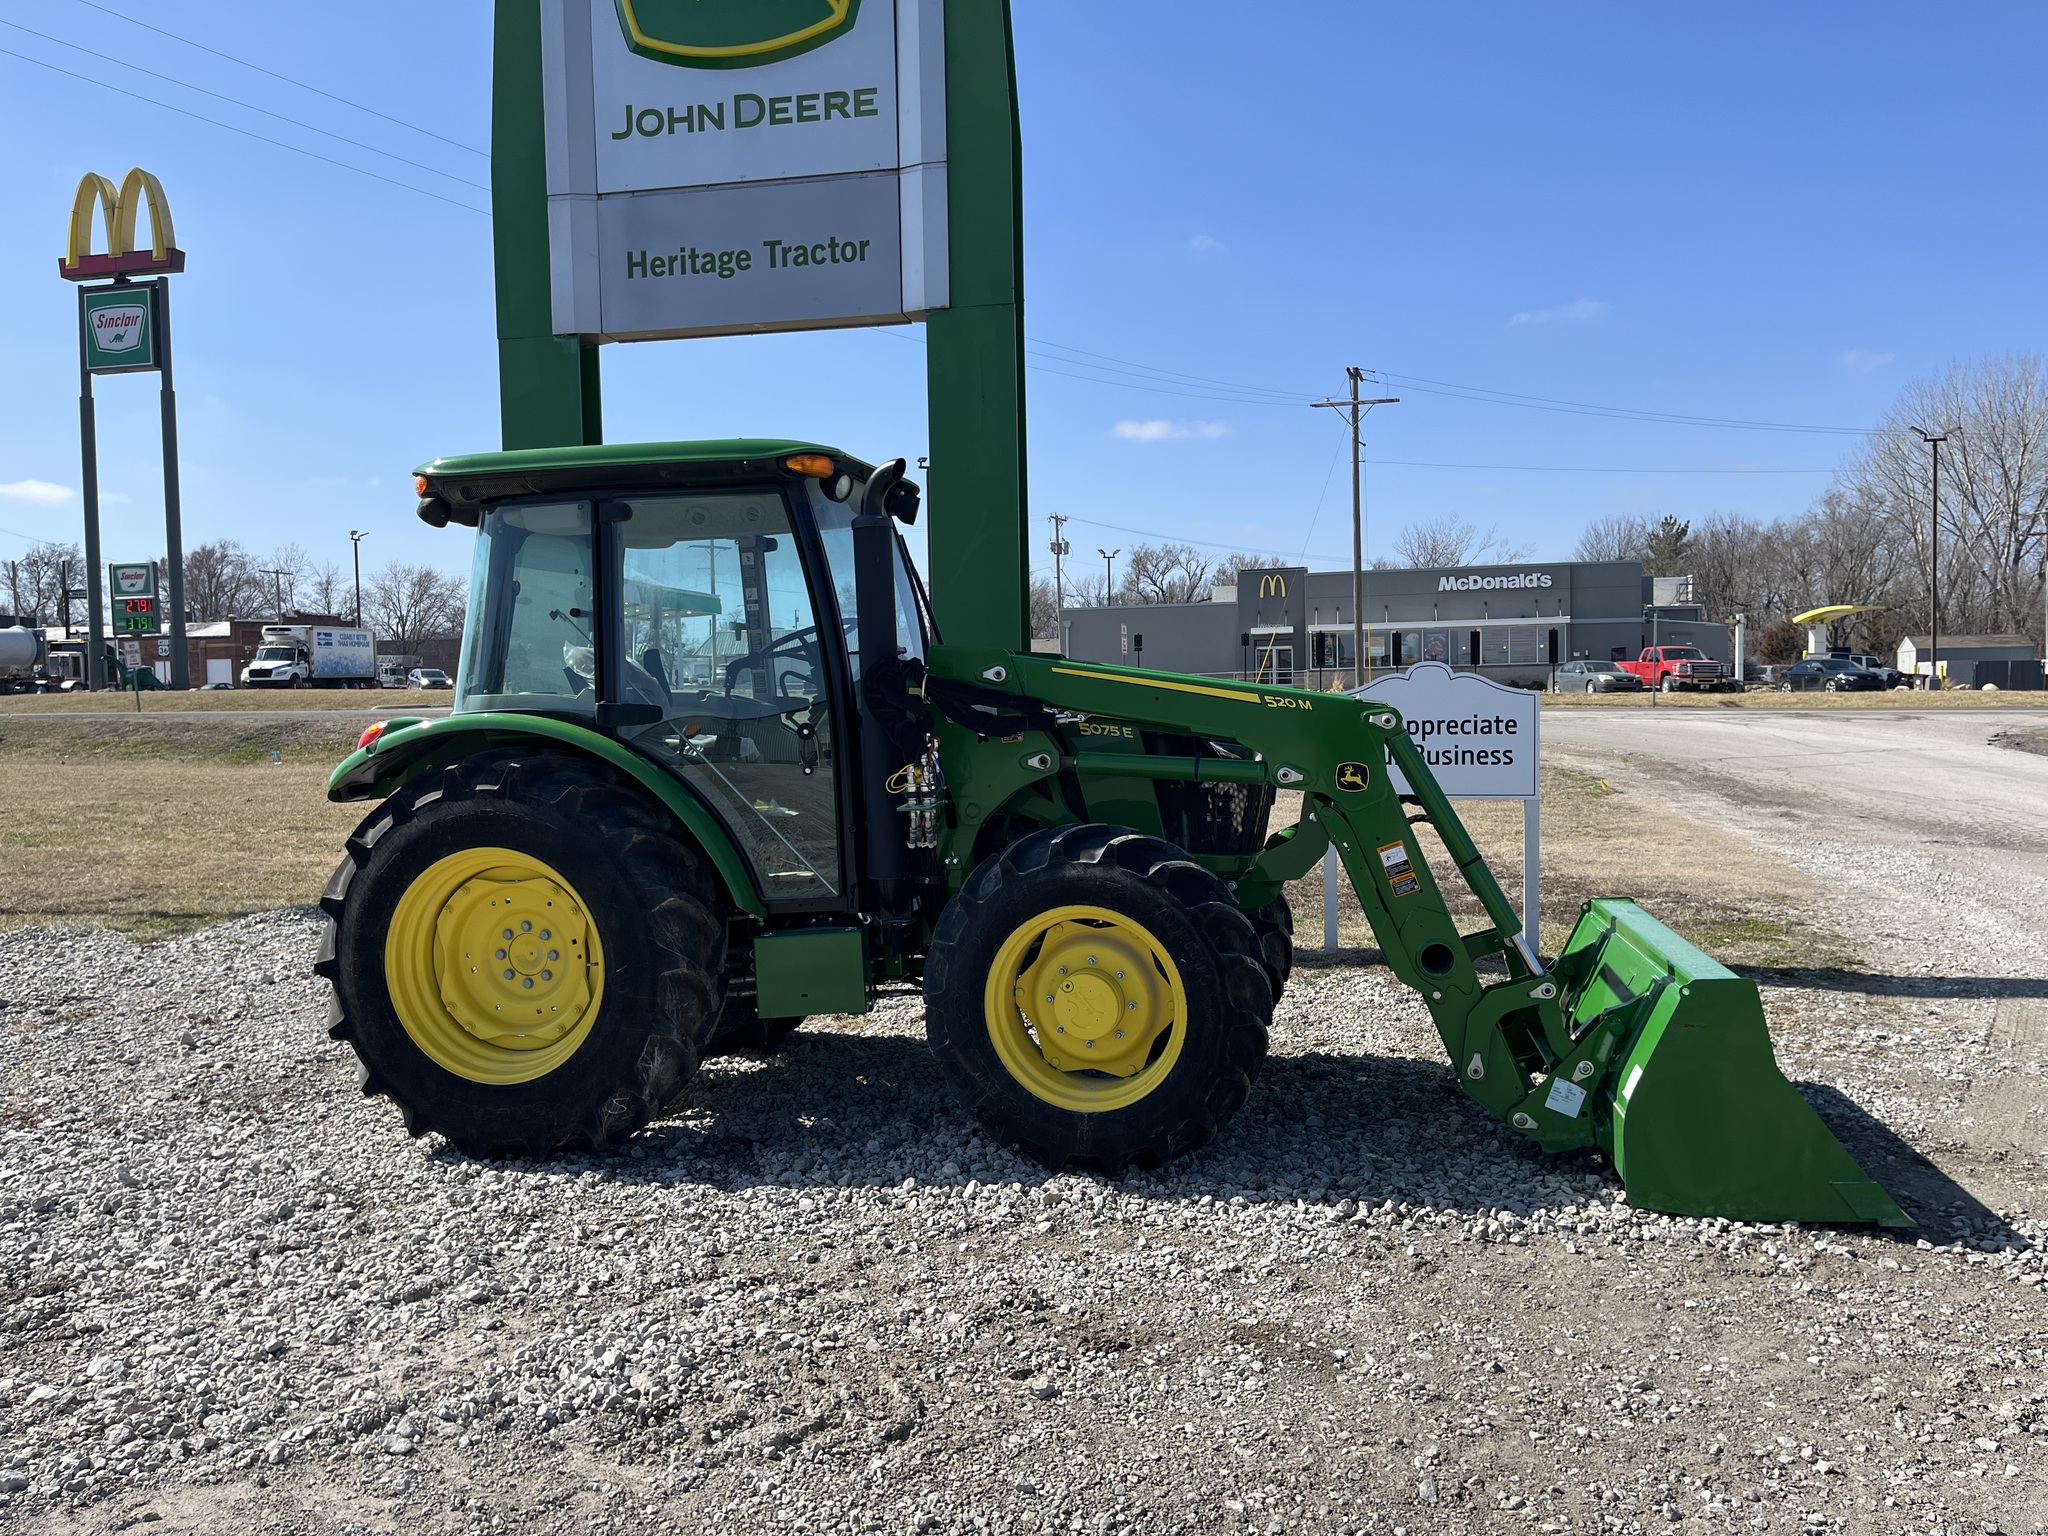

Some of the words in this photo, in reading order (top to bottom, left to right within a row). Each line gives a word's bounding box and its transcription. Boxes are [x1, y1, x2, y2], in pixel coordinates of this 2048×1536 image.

[611, 102, 725, 140] JOHN
[733, 87, 879, 129] DEERE
[626, 246, 752, 279] Heritage
[762, 236, 870, 268] Tractor
[96, 312, 141, 328] Sinclair
[120, 571, 145, 580] Sinclair
[1438, 572, 1553, 592] McDonald's
[1264, 695, 1297, 708] 520
[1298, 699, 1313, 710] M
[1079, 722, 1121, 737] 5075
[1122, 726, 1134, 739] E
[1406, 714, 1517, 741] ppreciate
